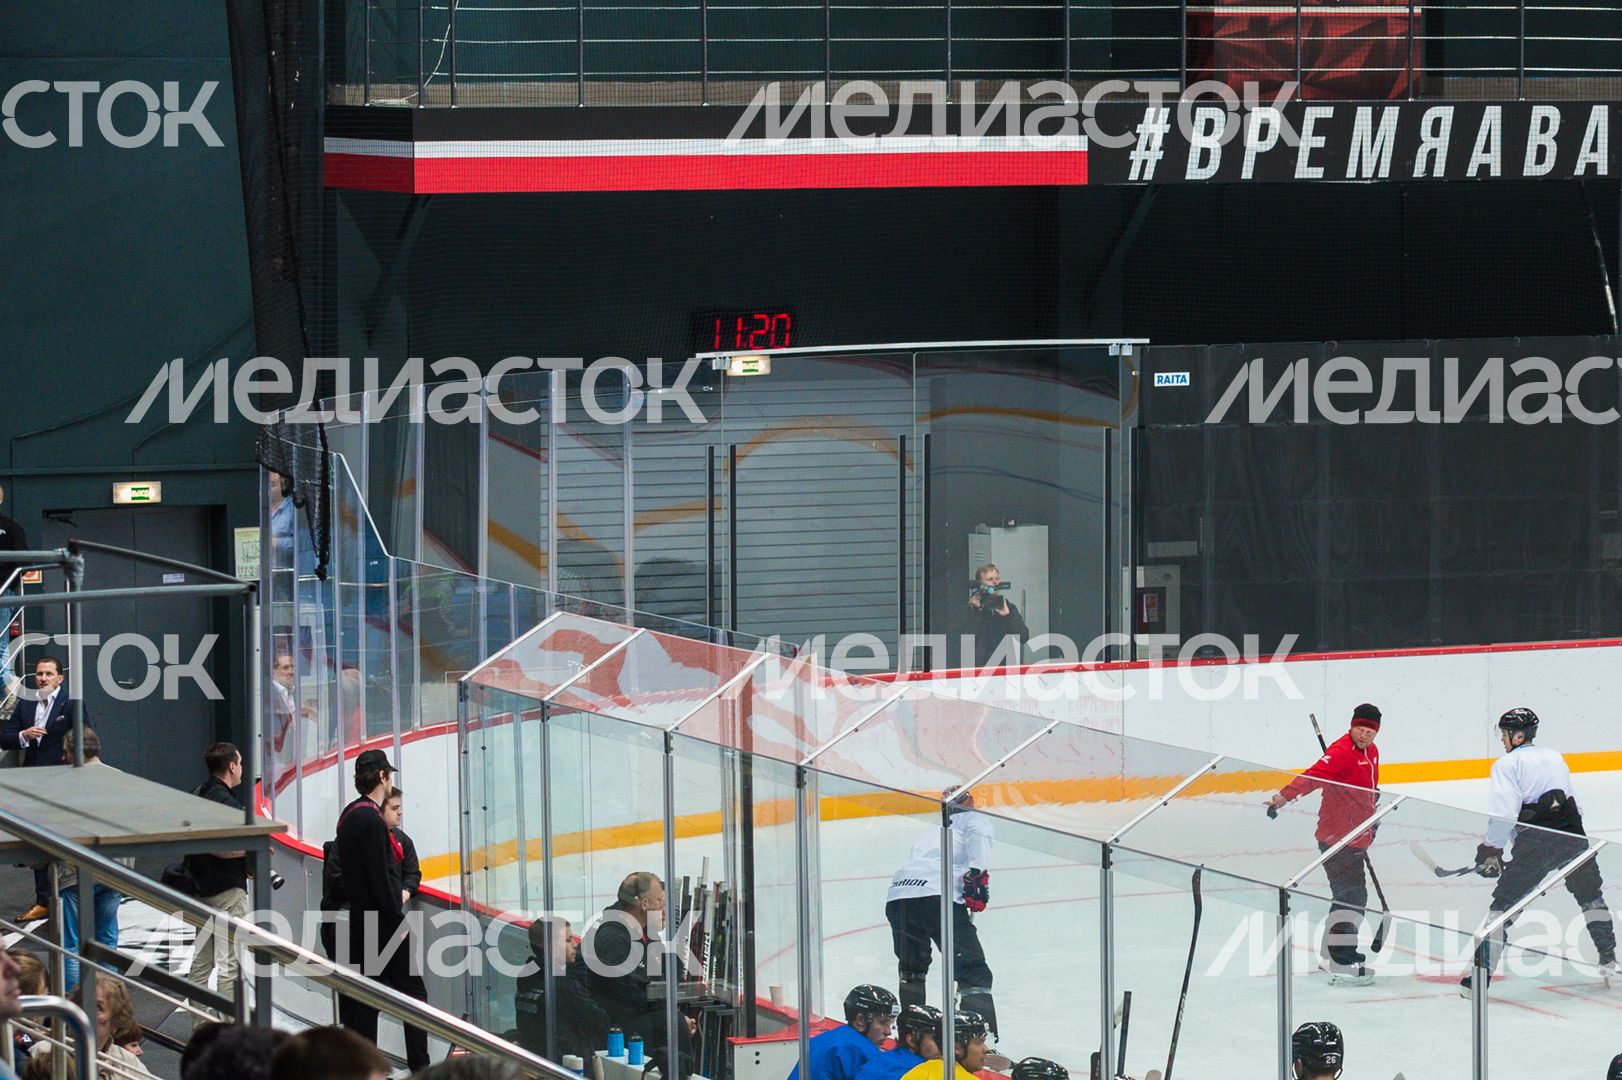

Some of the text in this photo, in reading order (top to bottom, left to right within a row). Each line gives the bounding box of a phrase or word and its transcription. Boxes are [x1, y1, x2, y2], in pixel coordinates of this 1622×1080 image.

[713, 313, 792, 350] 11:20
[1156, 374, 1188, 385] RAITA
[1325, 1055, 1337, 1064] 26
